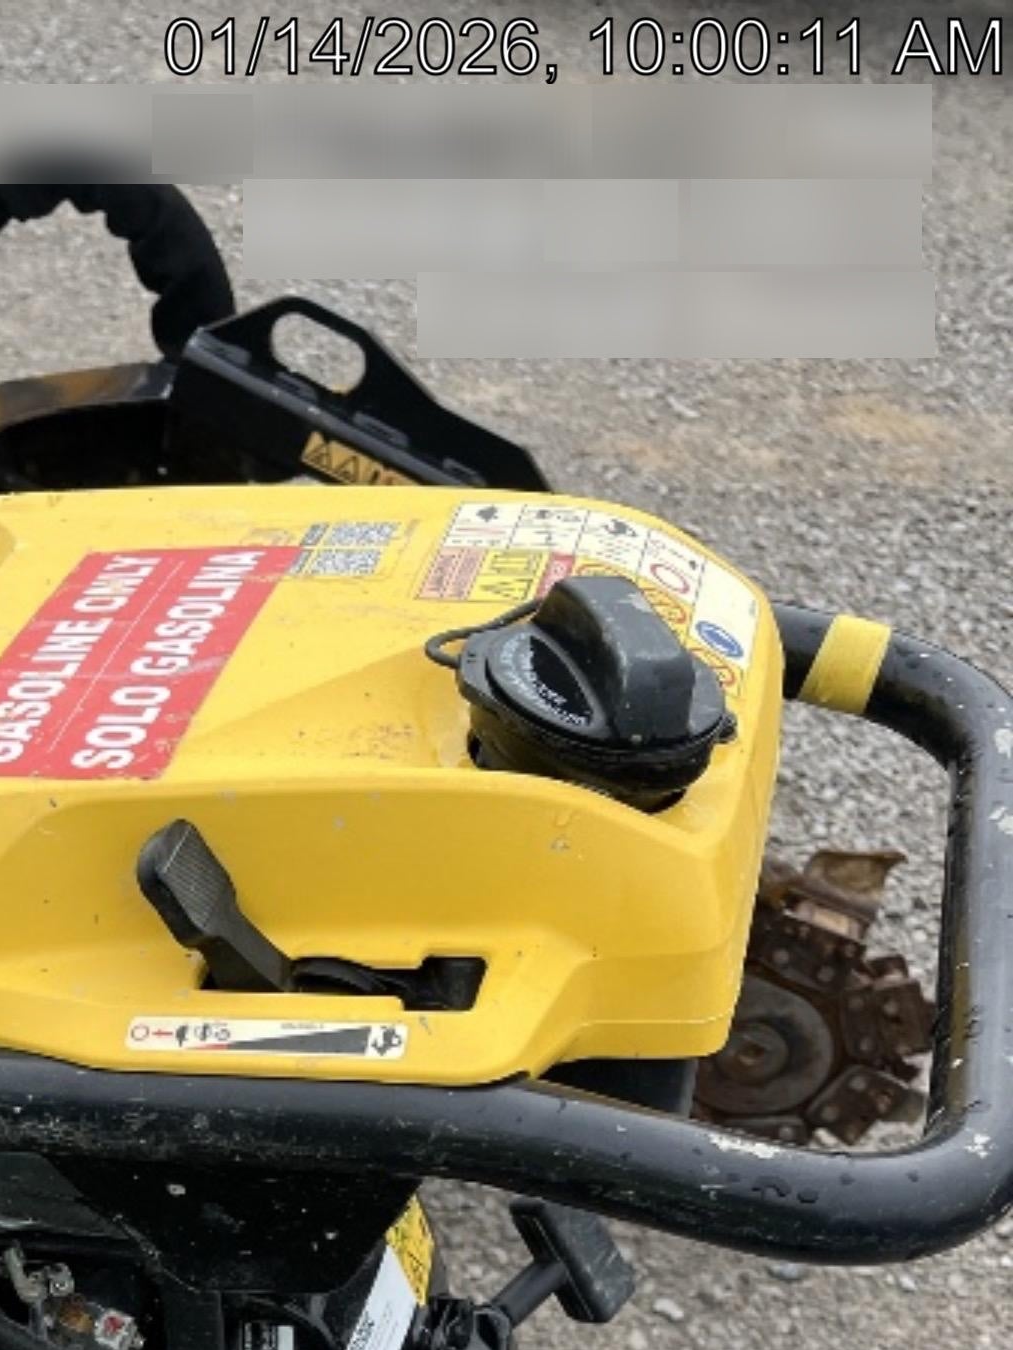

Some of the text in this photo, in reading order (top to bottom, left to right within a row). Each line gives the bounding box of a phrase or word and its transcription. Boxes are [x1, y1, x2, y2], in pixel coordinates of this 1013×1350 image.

[73, 554, 162, 614] ONLY
[70, 550, 266, 769] SOLO GASOLINA
